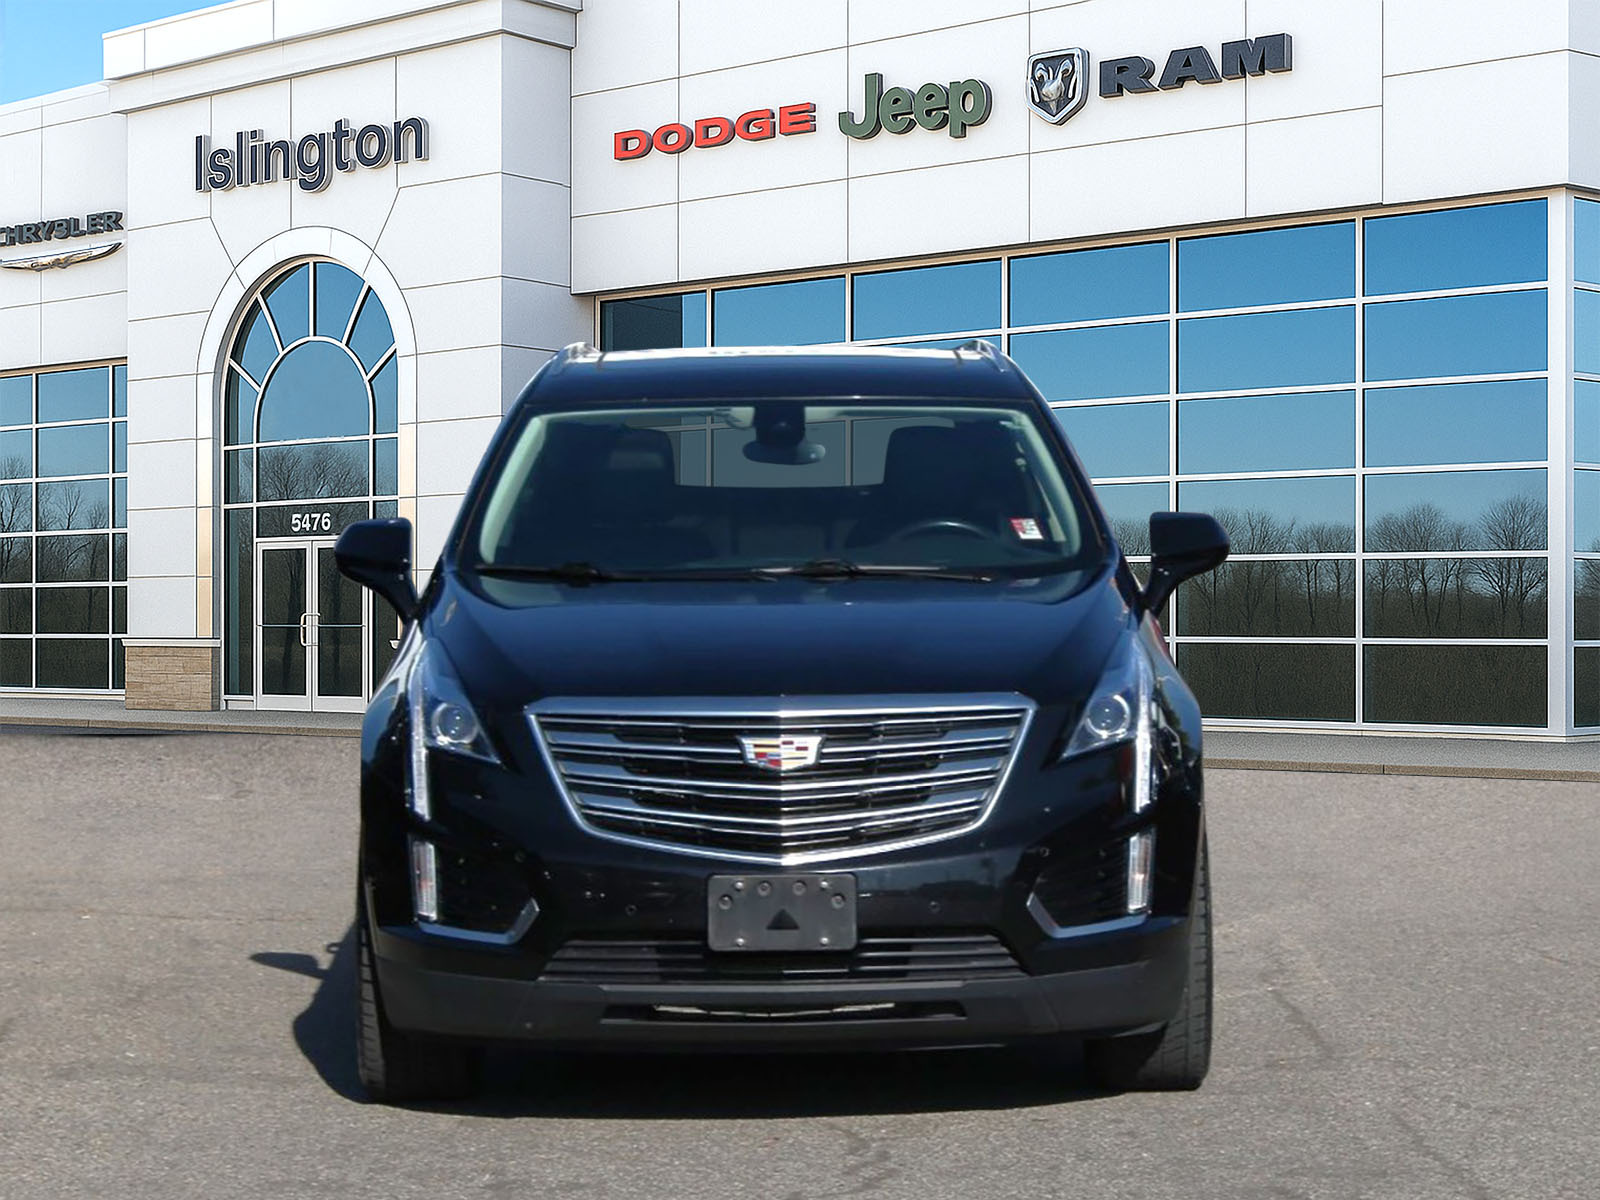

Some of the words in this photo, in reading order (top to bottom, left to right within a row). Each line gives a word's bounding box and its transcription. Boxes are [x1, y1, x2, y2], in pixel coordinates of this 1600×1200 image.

[614, 102, 817, 161] DODGE
[838, 72, 993, 140] Jeep
[1099, 33, 1293, 98] RAM
[195, 116, 430, 193] Islington
[291, 512, 331, 532] 5476
